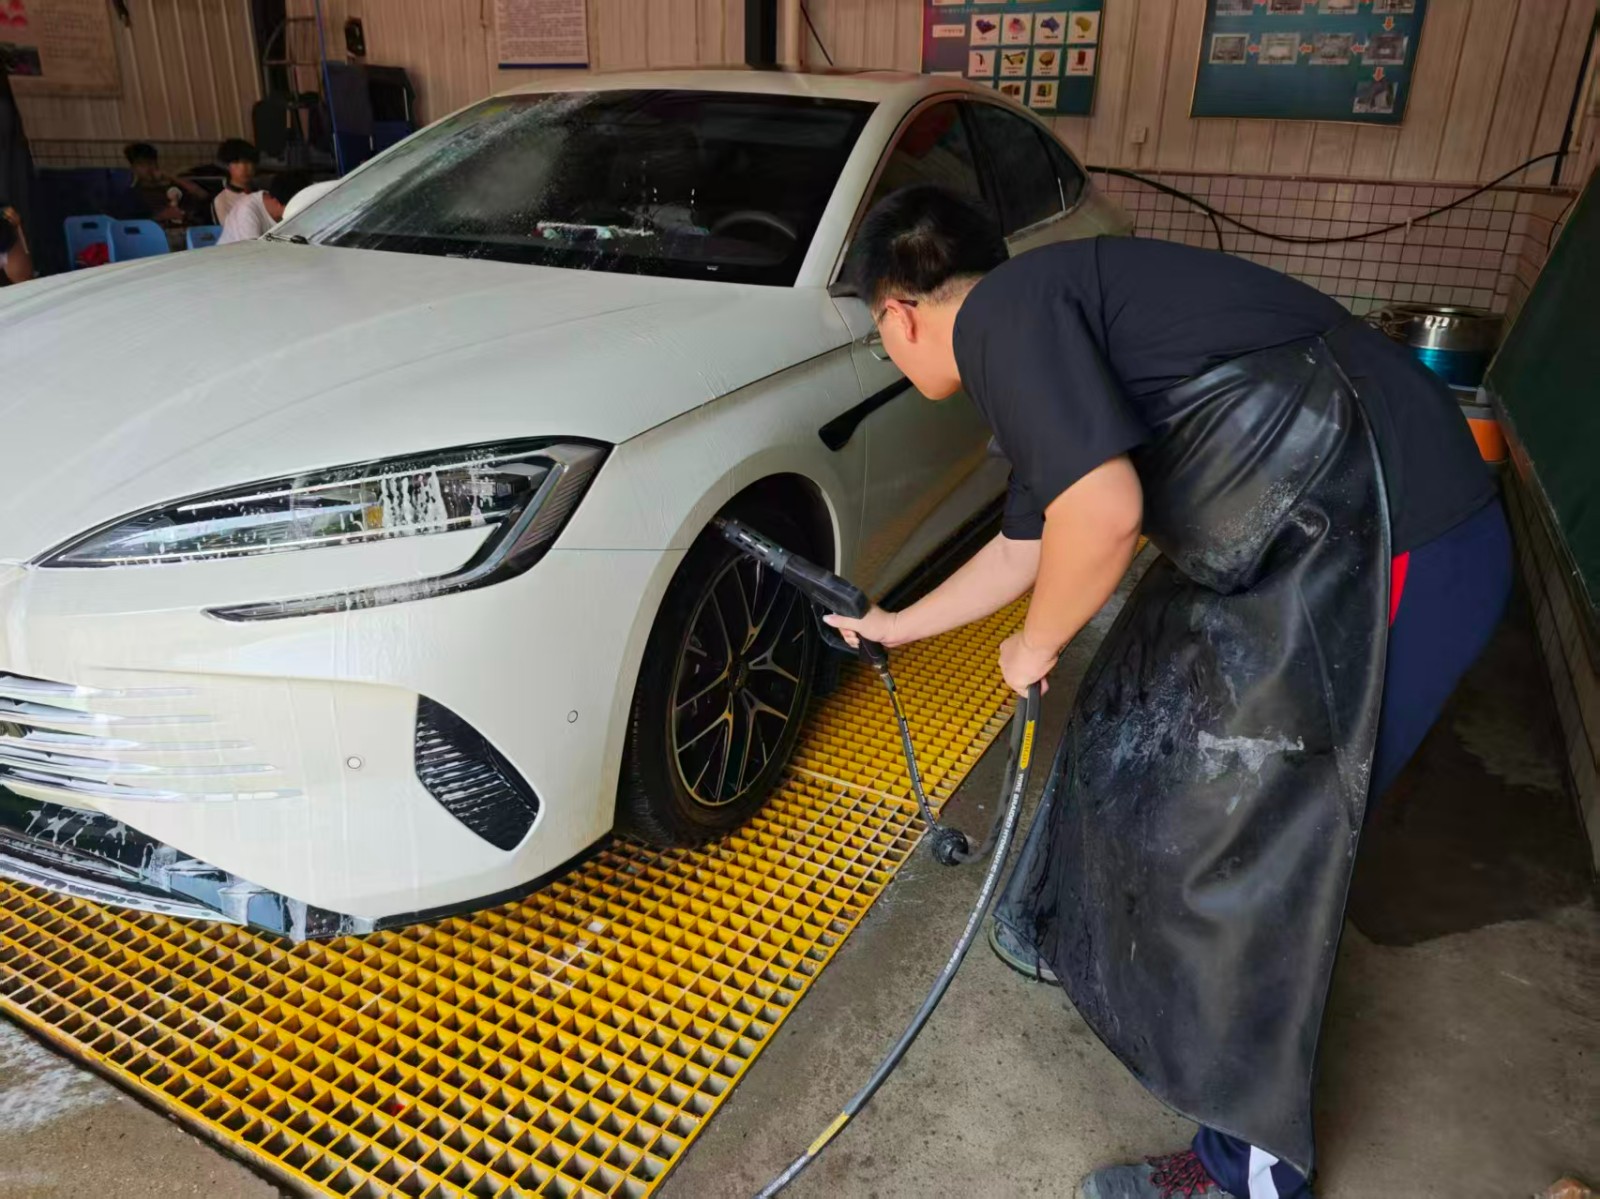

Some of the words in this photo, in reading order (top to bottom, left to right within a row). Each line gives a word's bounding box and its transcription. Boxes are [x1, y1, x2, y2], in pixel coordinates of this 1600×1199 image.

[1015, 773, 1024, 793] WIRE
[1005, 793, 1019, 828] BRAIDED
[990, 828, 1009, 872] HYDRAULIC
